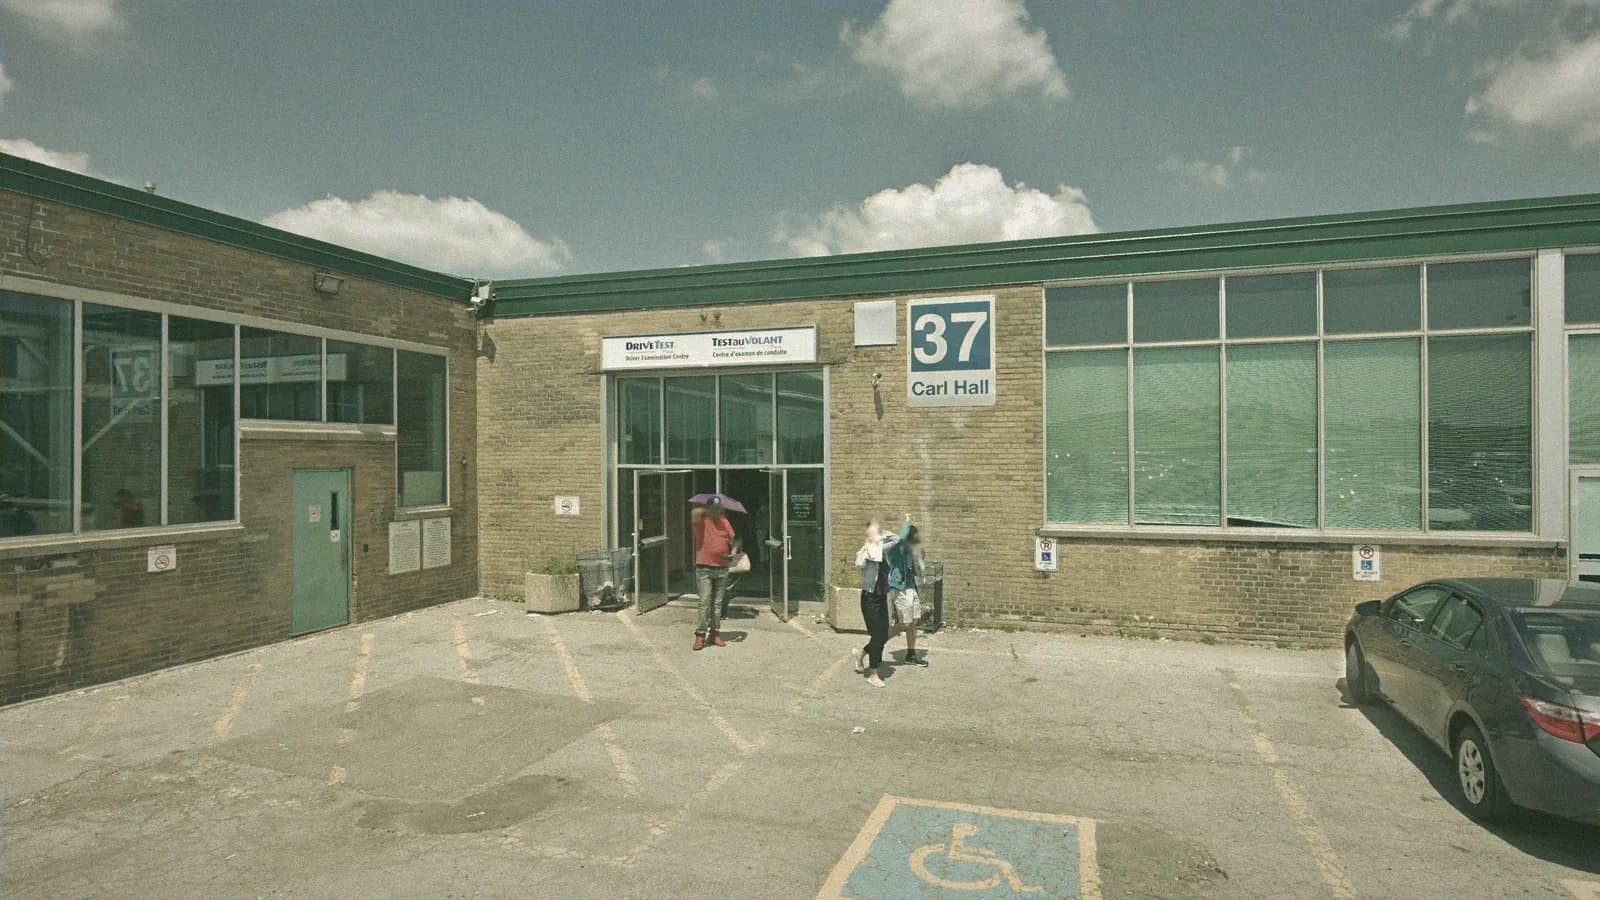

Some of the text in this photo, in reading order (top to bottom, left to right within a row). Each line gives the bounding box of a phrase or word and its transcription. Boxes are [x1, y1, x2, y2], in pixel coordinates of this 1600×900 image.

[913, 311, 987, 365] 37
[911, 379, 989, 396] Carl Hall
